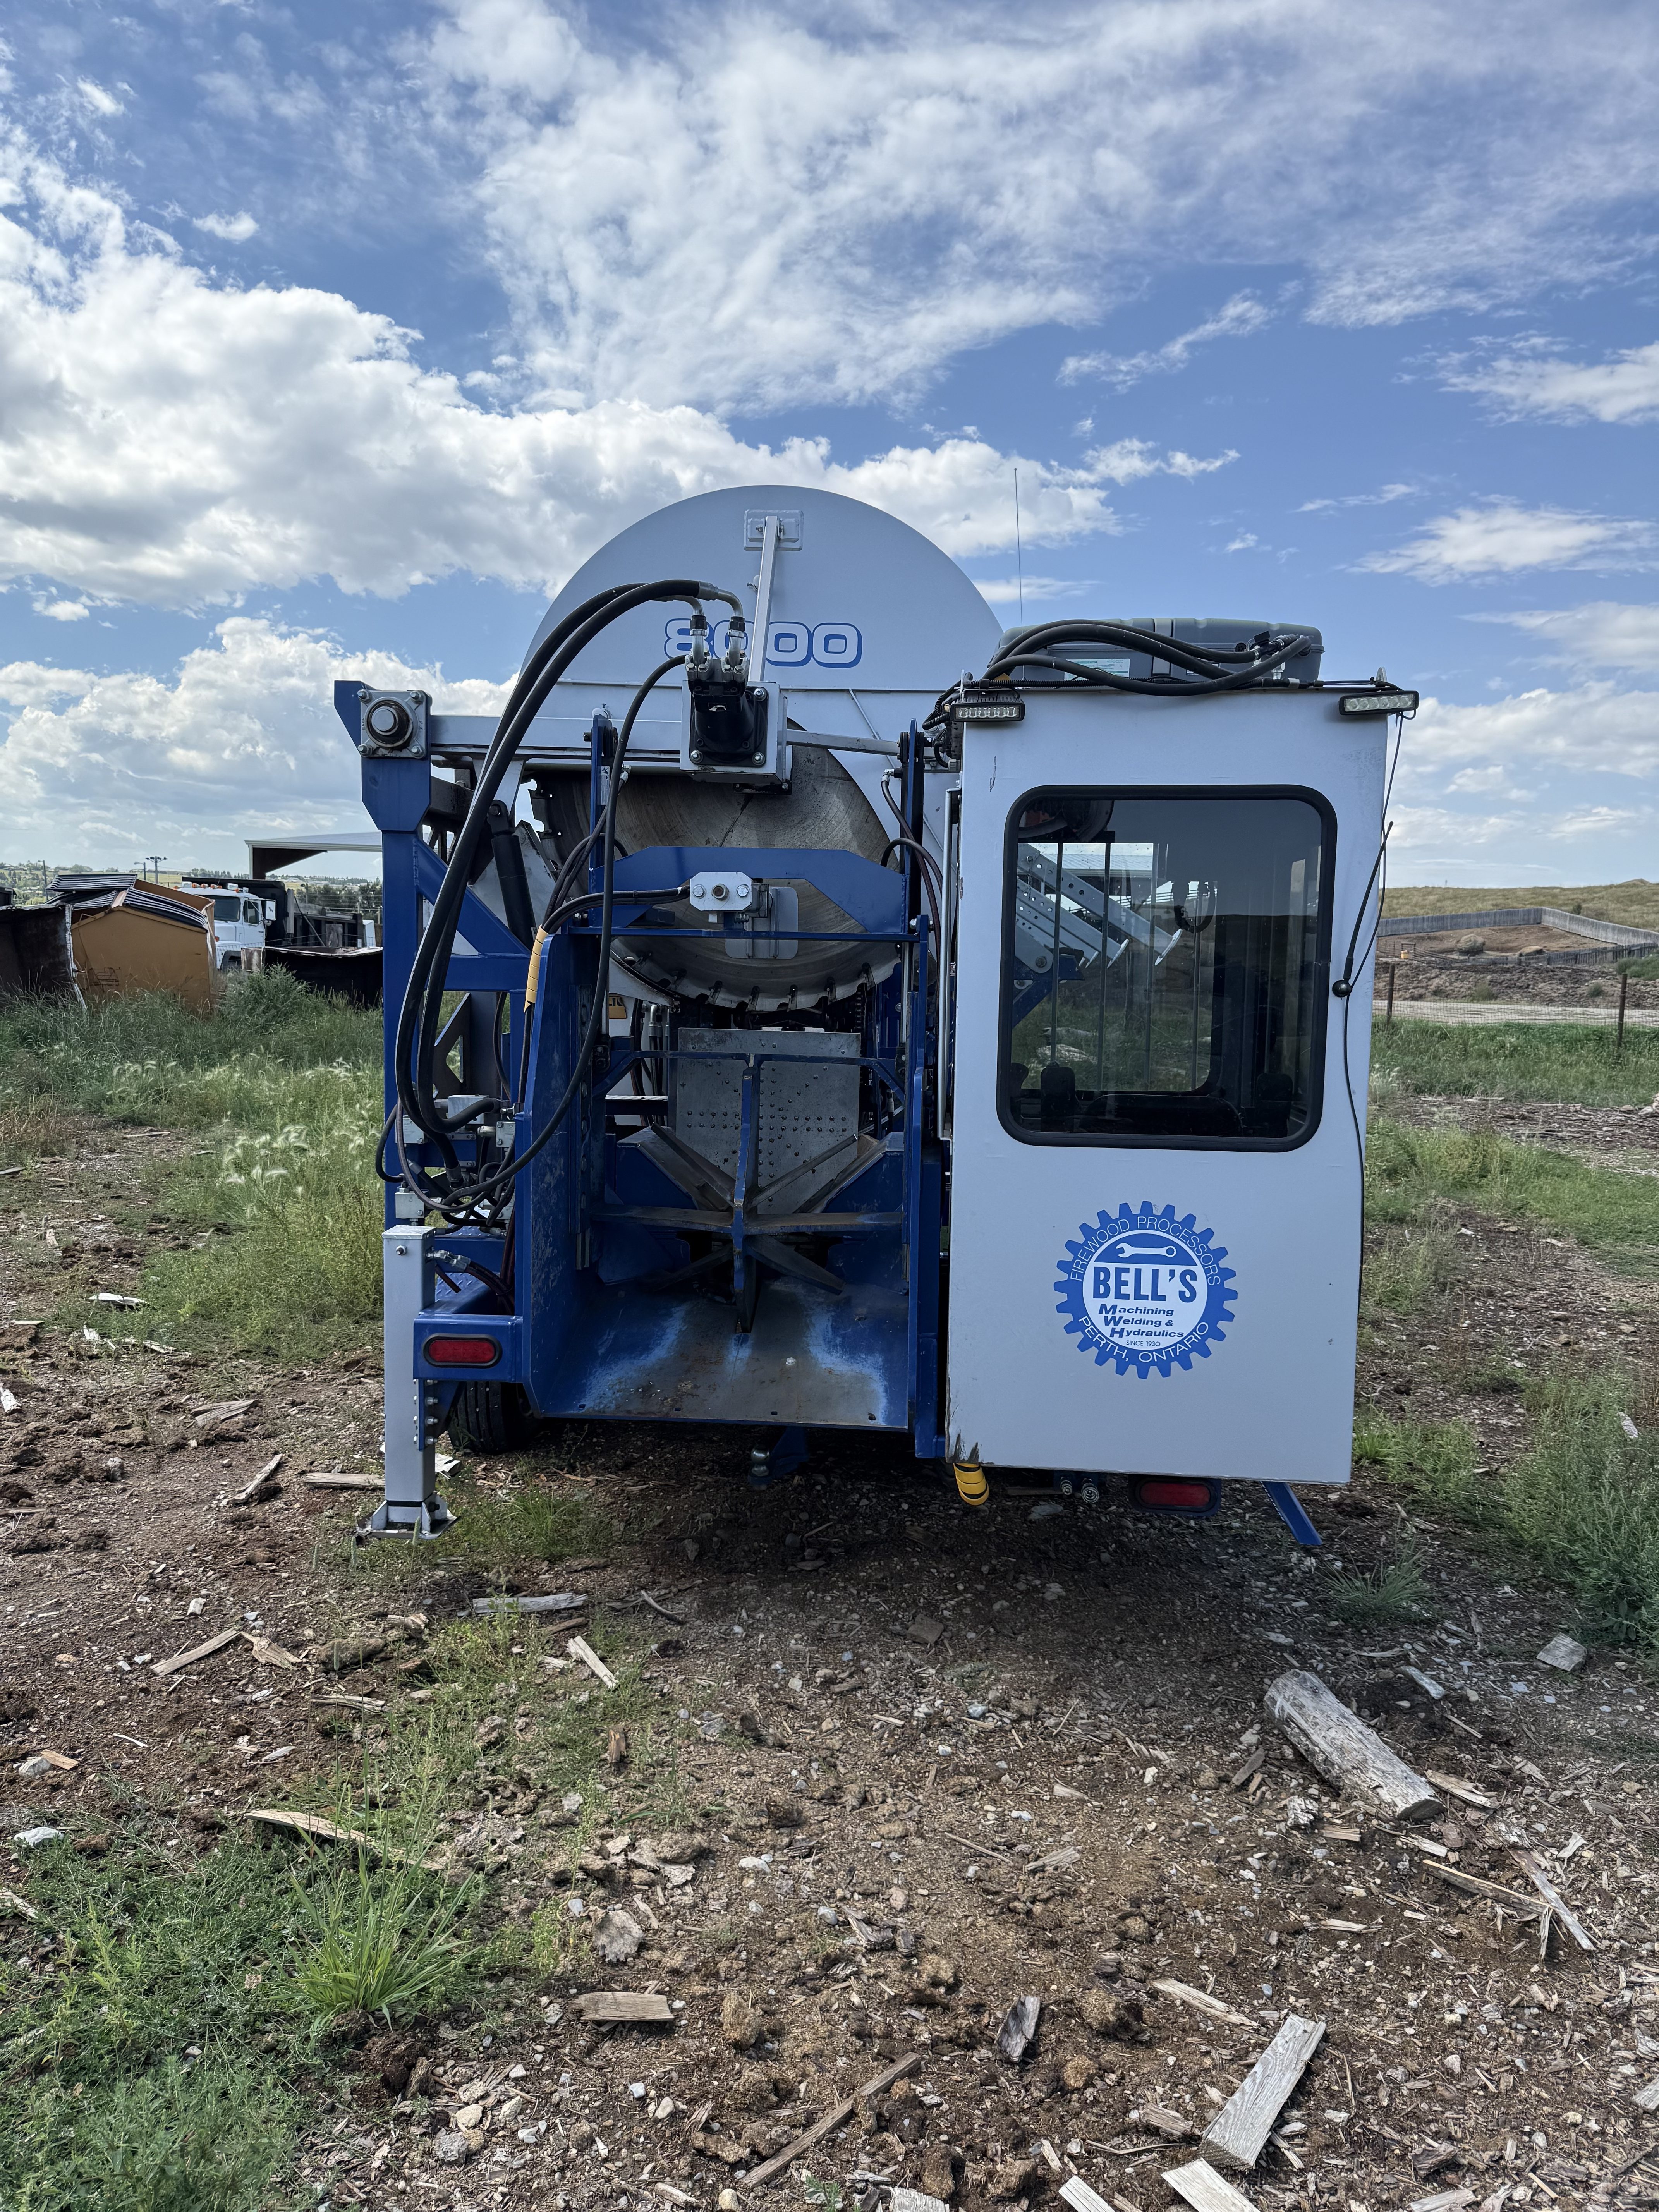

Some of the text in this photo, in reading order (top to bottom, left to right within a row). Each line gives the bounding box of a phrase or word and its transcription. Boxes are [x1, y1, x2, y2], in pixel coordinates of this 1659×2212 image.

[664, 618, 862, 668] 8000
[1070, 1216, 1221, 1286] FIREWOOD PROCESSORS
[1093, 1266, 1197, 1303] BELL'S
[1098, 1304, 1174, 1316] Machining
[1103, 1315, 1162, 1328] Welding
[1078, 1316, 1209, 1362] PERTH, ONTARIO
[1109, 1327, 1184, 1338] Hydraulics
